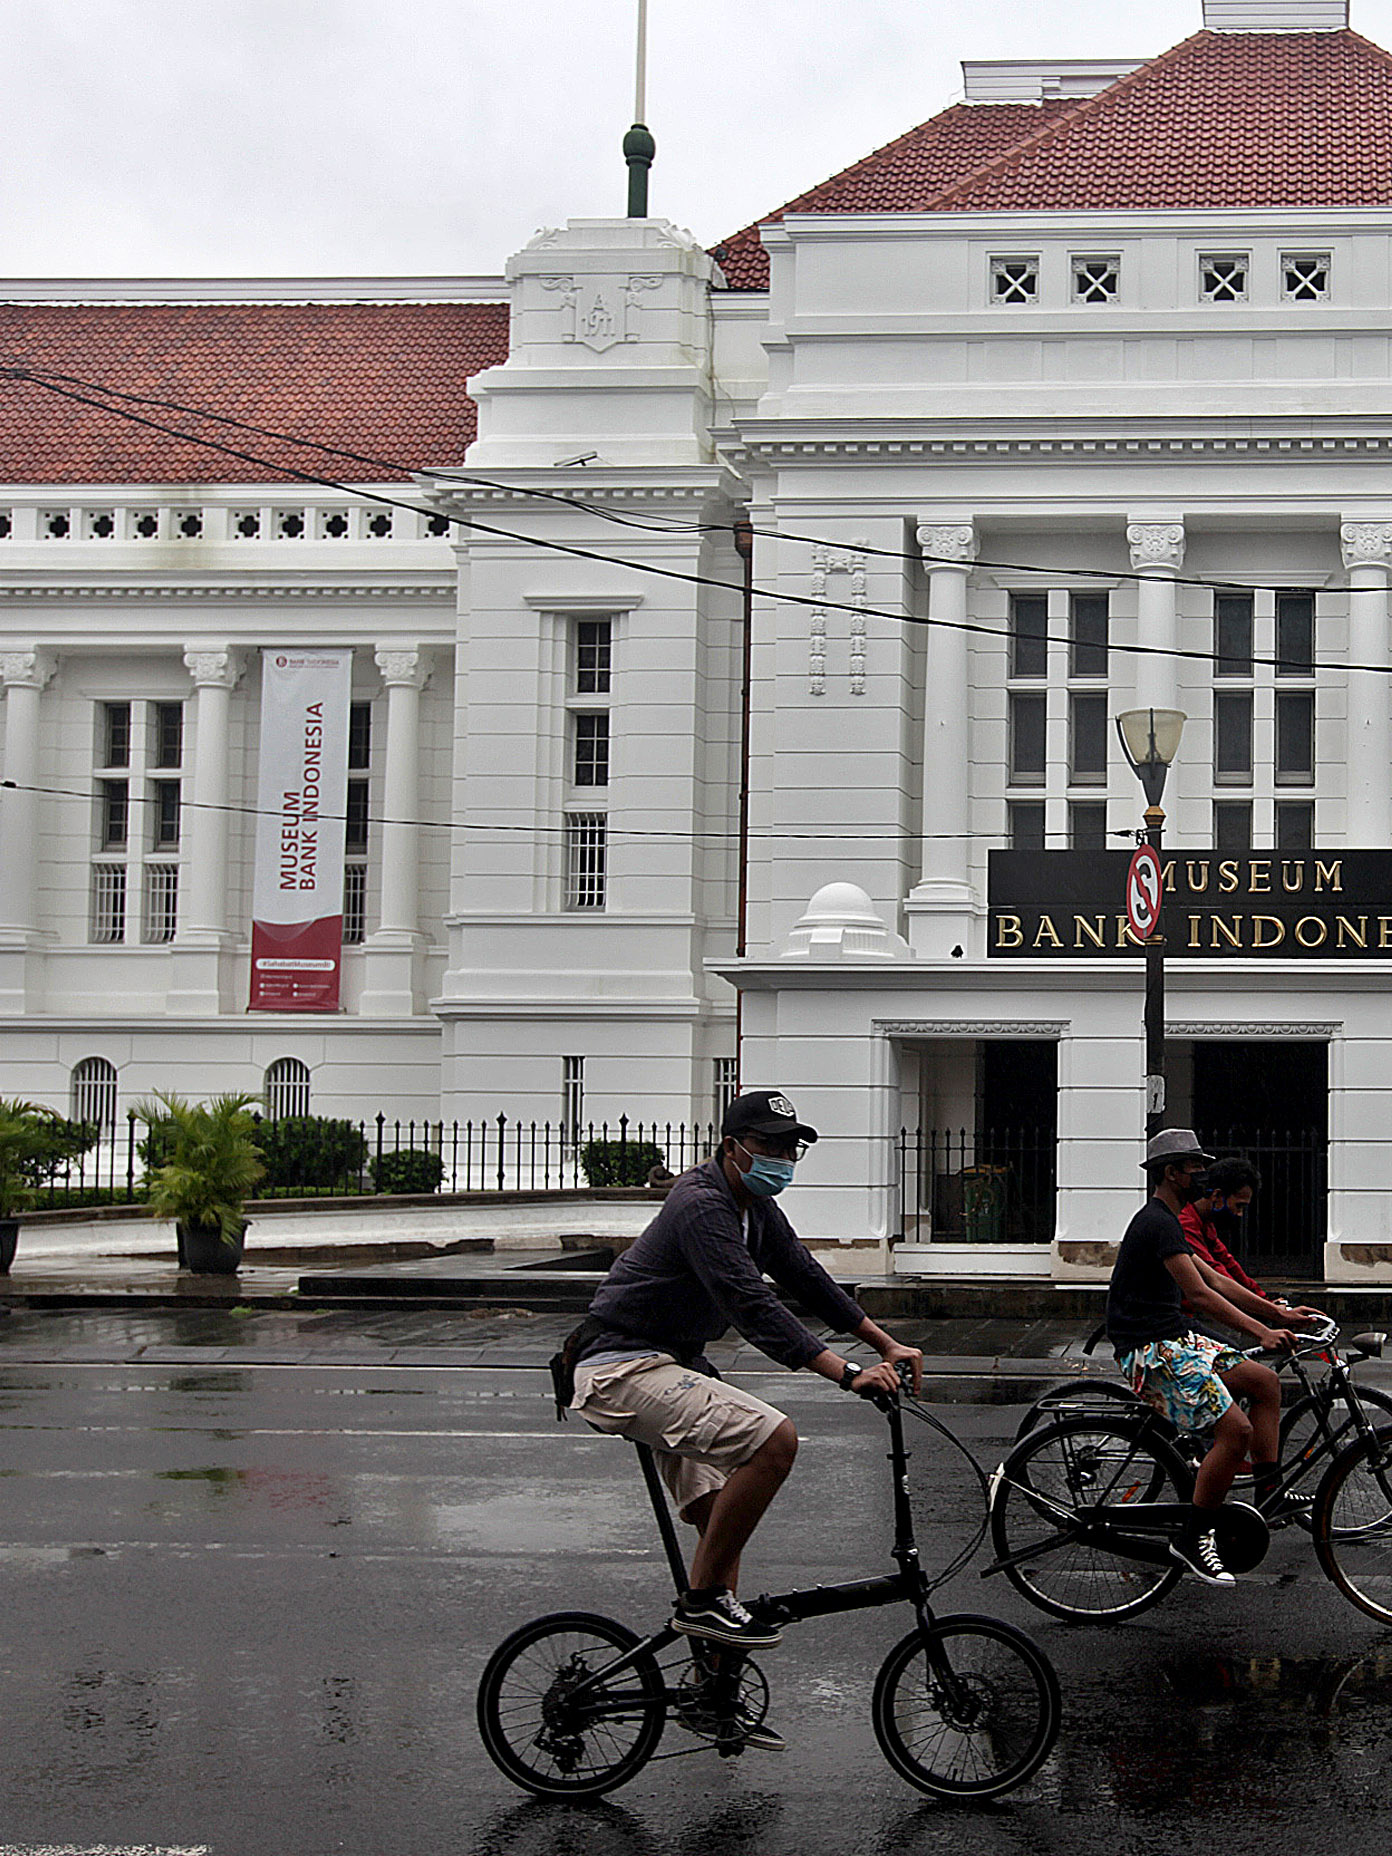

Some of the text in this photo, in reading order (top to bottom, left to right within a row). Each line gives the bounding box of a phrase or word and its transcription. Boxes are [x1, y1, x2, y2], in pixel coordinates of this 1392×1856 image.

[581, 313, 617, 337] 1911
[299, 702, 324, 891] BANK INDONESIA
[280, 791, 301, 891] MUSEUM
[995, 915, 1146, 948] BANK
